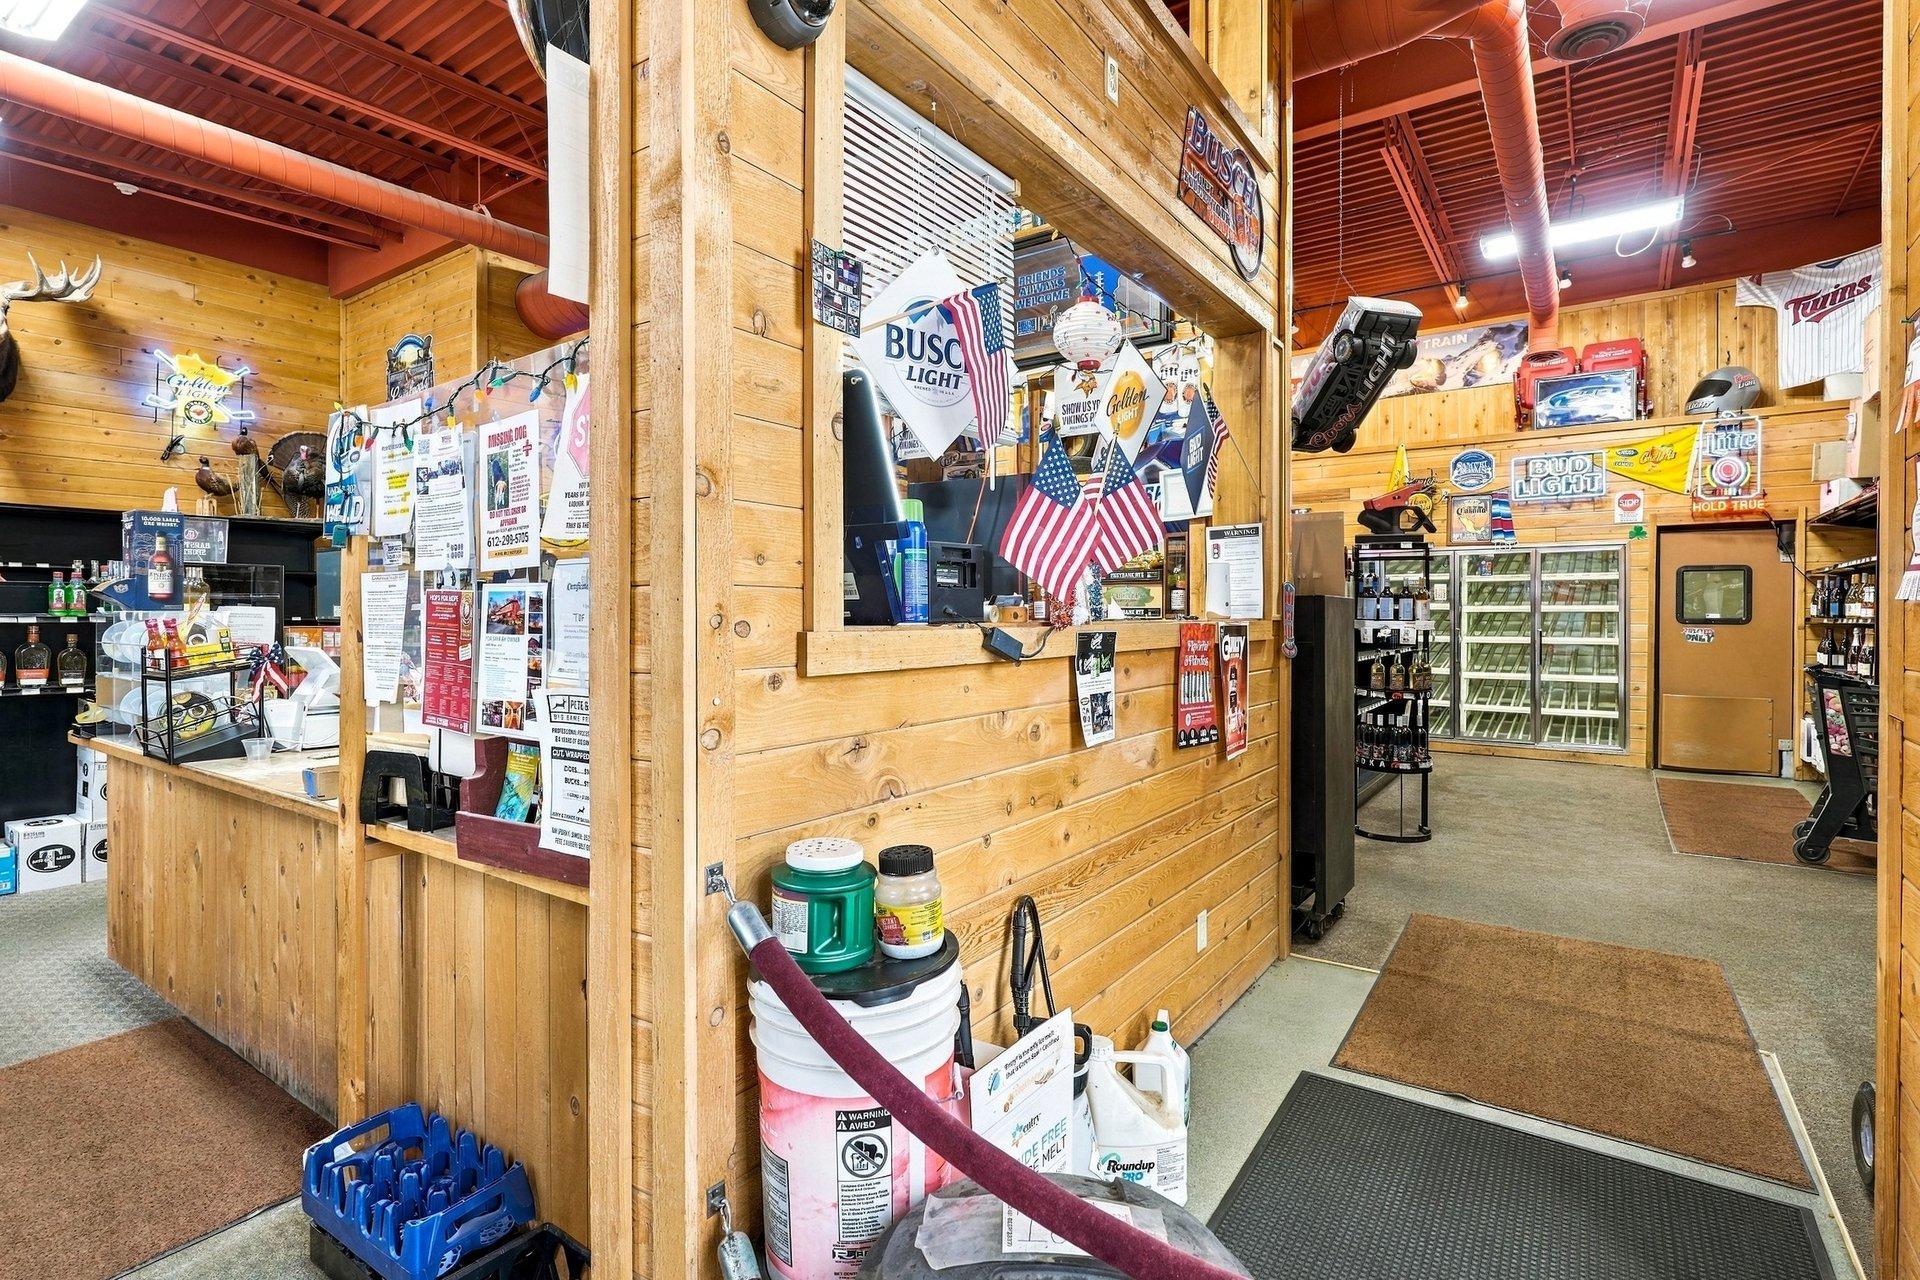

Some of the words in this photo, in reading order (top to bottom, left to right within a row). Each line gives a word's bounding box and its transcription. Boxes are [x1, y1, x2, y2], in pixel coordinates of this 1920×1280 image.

[1189, 108, 1258, 217] BUSCH
[1019, 266, 1066, 287] FRIENDS
[1019, 278, 1066, 297] ALWAYS
[1014, 288, 1070, 310] WELCOME
[1785, 274, 1873, 326] Twins
[886, 323, 969, 374] BUSC
[1423, 334, 1468, 349] TRAIN
[1356, 323, 1397, 401] LIGHT
[906, 365, 964, 390] LIGHT
[1738, 380, 1757, 389] LIGHT
[1062, 401, 1081, 415] SHOW
[1082, 400, 1092, 412] US
[1106, 387, 1150, 417] Golden
[1062, 413, 1089, 425] VIKINGS
[1306, 401, 1362, 448] Coors
[488, 428, 514, 448] MISSING
[514, 425, 527, 441] DOG
[1189, 433, 1202, 449] BUD
[1187, 447, 1204, 469] LIGHT
[1529, 455, 1591, 478] BUD
[1515, 473, 1603, 498] LIGHT
[1693, 500, 1727, 512] HOLD
[1732, 500, 1765, 511] TRUE
[1224, 529, 1256, 537] WARNING
[1686, 634, 1714, 642] ONLY
[571, 700, 583, 710] PETE
[1042, 1035, 1060, 1051] Certified
[849, 1121, 876, 1130] AVISO
[1041, 1117, 1067, 1150] FREE
[1042, 1134, 1067, 1167] MELT
[1106, 1160, 1155, 1173] Roundup
[1122, 1172, 1144, 1182] PRO
